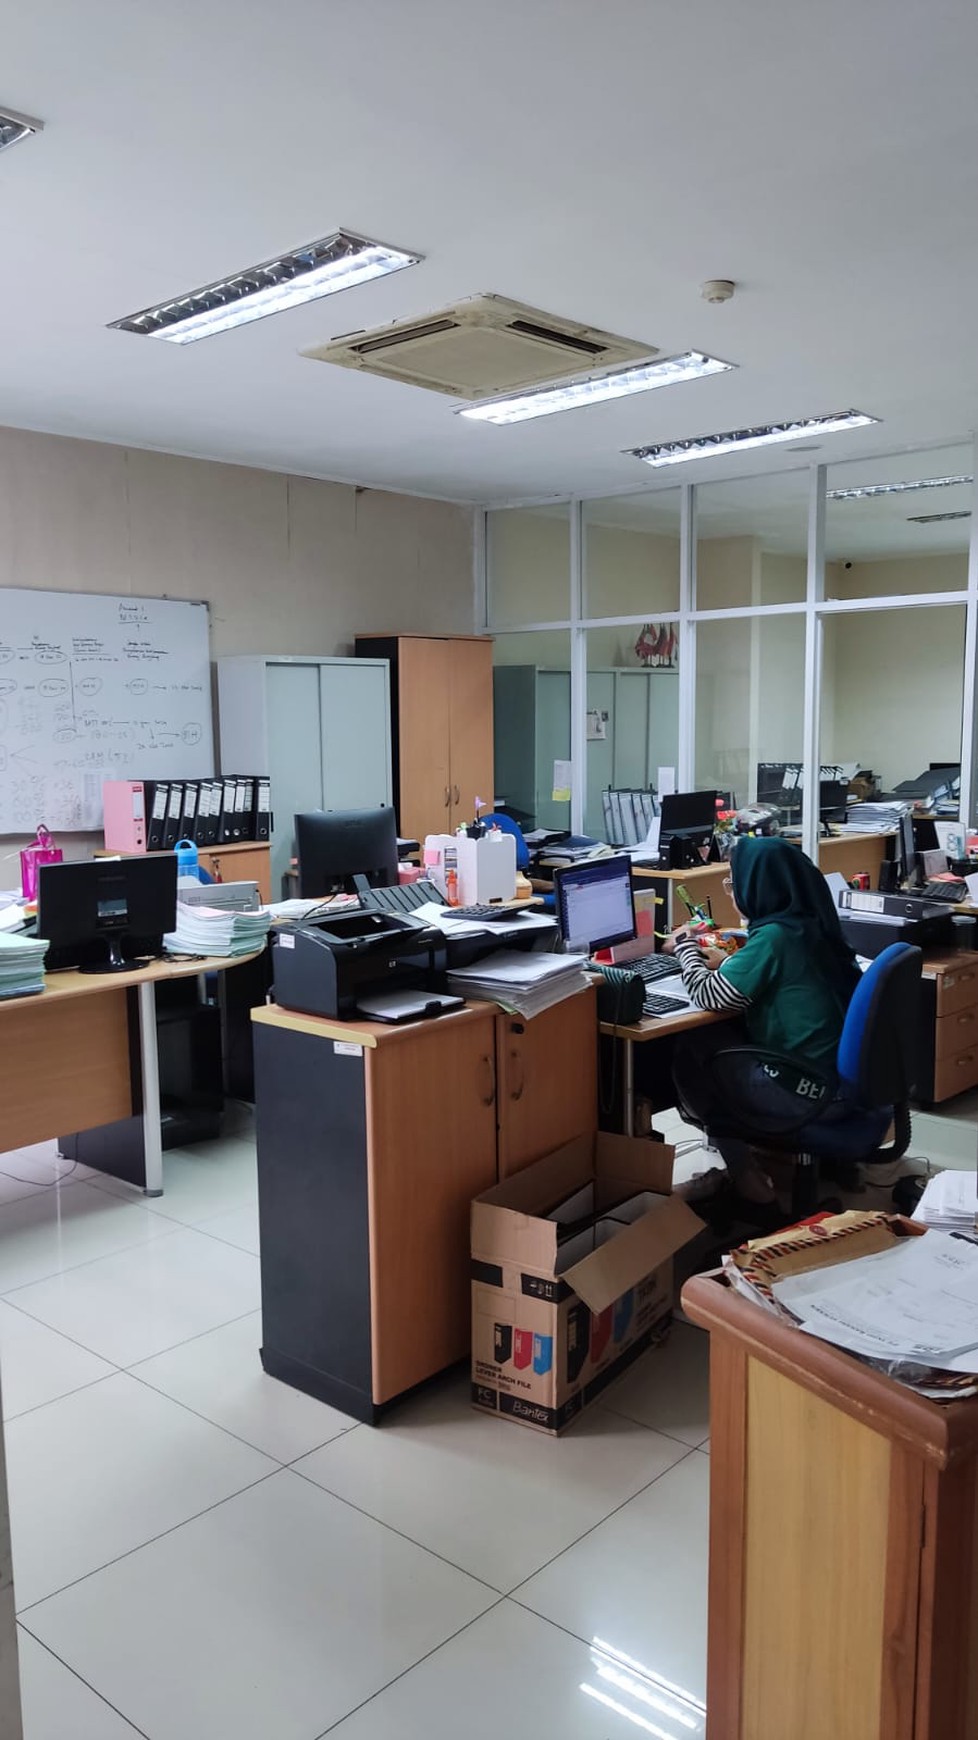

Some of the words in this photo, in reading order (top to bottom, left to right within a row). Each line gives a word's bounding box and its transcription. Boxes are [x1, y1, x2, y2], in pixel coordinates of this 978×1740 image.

[498, 1375, 516, 1385] ARCH
[517, 1379, 532, 1389] FILE
[513, 1400, 549, 1422] Bantex
